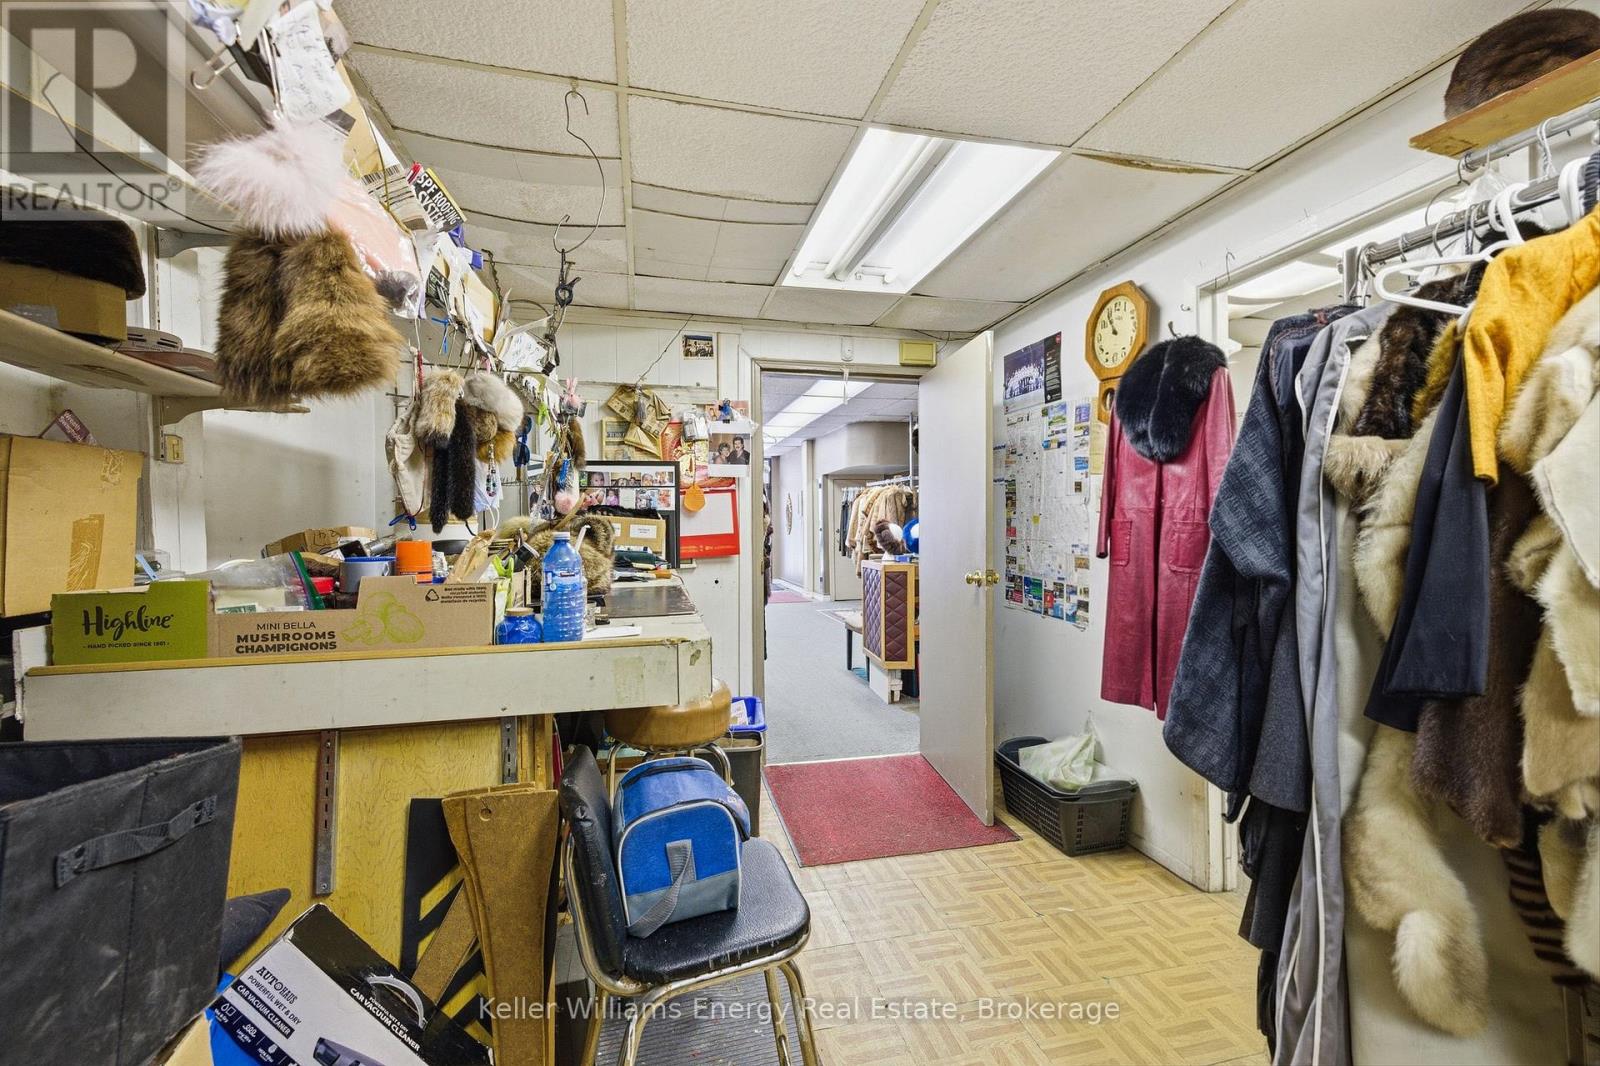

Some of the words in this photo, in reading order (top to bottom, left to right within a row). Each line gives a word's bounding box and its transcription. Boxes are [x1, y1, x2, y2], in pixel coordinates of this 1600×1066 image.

[416, 173, 437, 193] SPF
[434, 190, 461, 225] ROOFING
[82, 605, 171, 641] Highline
[236, 630, 336, 643] MUSHROOMS
[256, 623, 280, 631] MINI
[283, 621, 317, 630] BELLA
[235, 641, 337, 654] CHAMPIGNONS
[247, 975, 276, 1002] POWERFUL
[274, 998, 287, 1011] WET
[288, 1013, 302, 1025] DRY
[256, 966, 298, 1005] AUTOHAUS
[237, 984, 249, 997] CAR
[246, 994, 270, 1016] VACUUM
[267, 1012, 291, 1036] CLEANER
[350, 988, 365, 1002] CAR
[364, 999, 392, 1027] VACUUM
[391, 1024, 421, 1052] CLEANER
